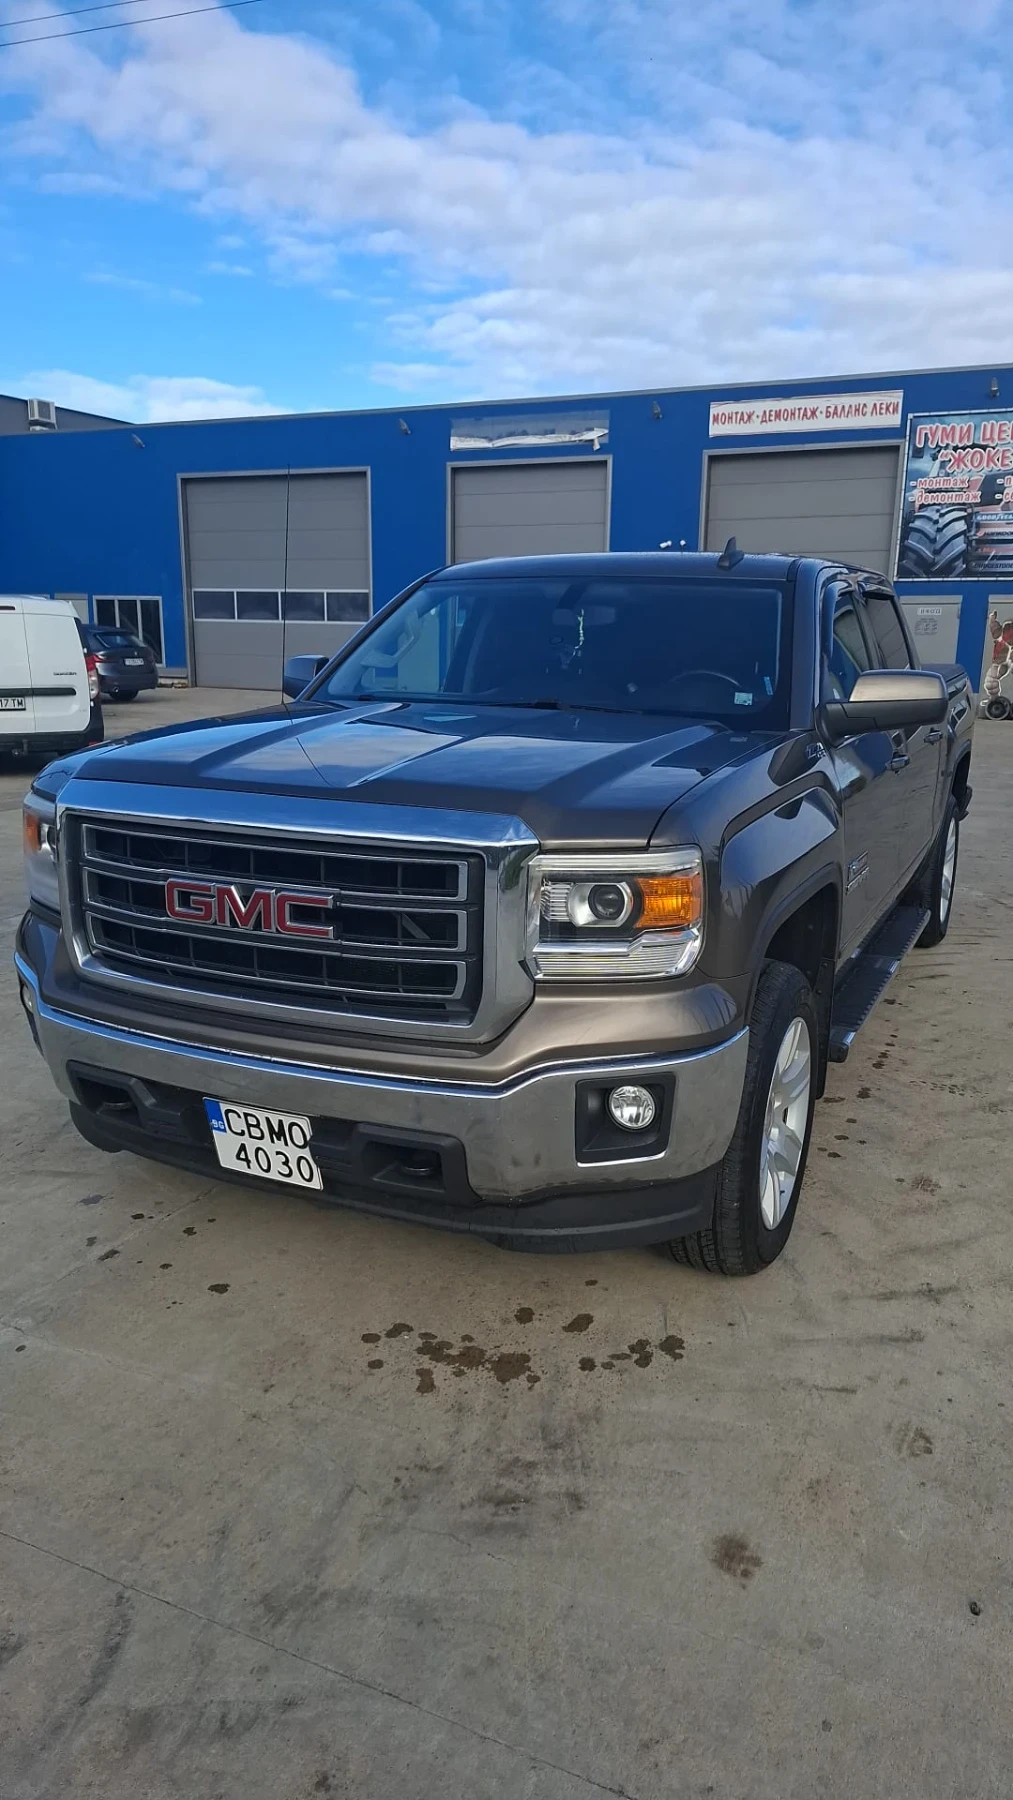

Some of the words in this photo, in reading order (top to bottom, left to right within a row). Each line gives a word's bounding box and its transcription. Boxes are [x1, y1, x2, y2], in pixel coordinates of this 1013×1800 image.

[712, 410, 755, 426] МОНТАЖ
[760, 406, 819, 425] ДЕМОНТАЖ
[870, 400, 899, 416] ЛЕКИ
[916, 422, 974, 448] ГУМИ
[11, 698, 24, 707] TM
[165, 878, 334, 939] GMC
[235, 1142, 314, 1182] 4030
